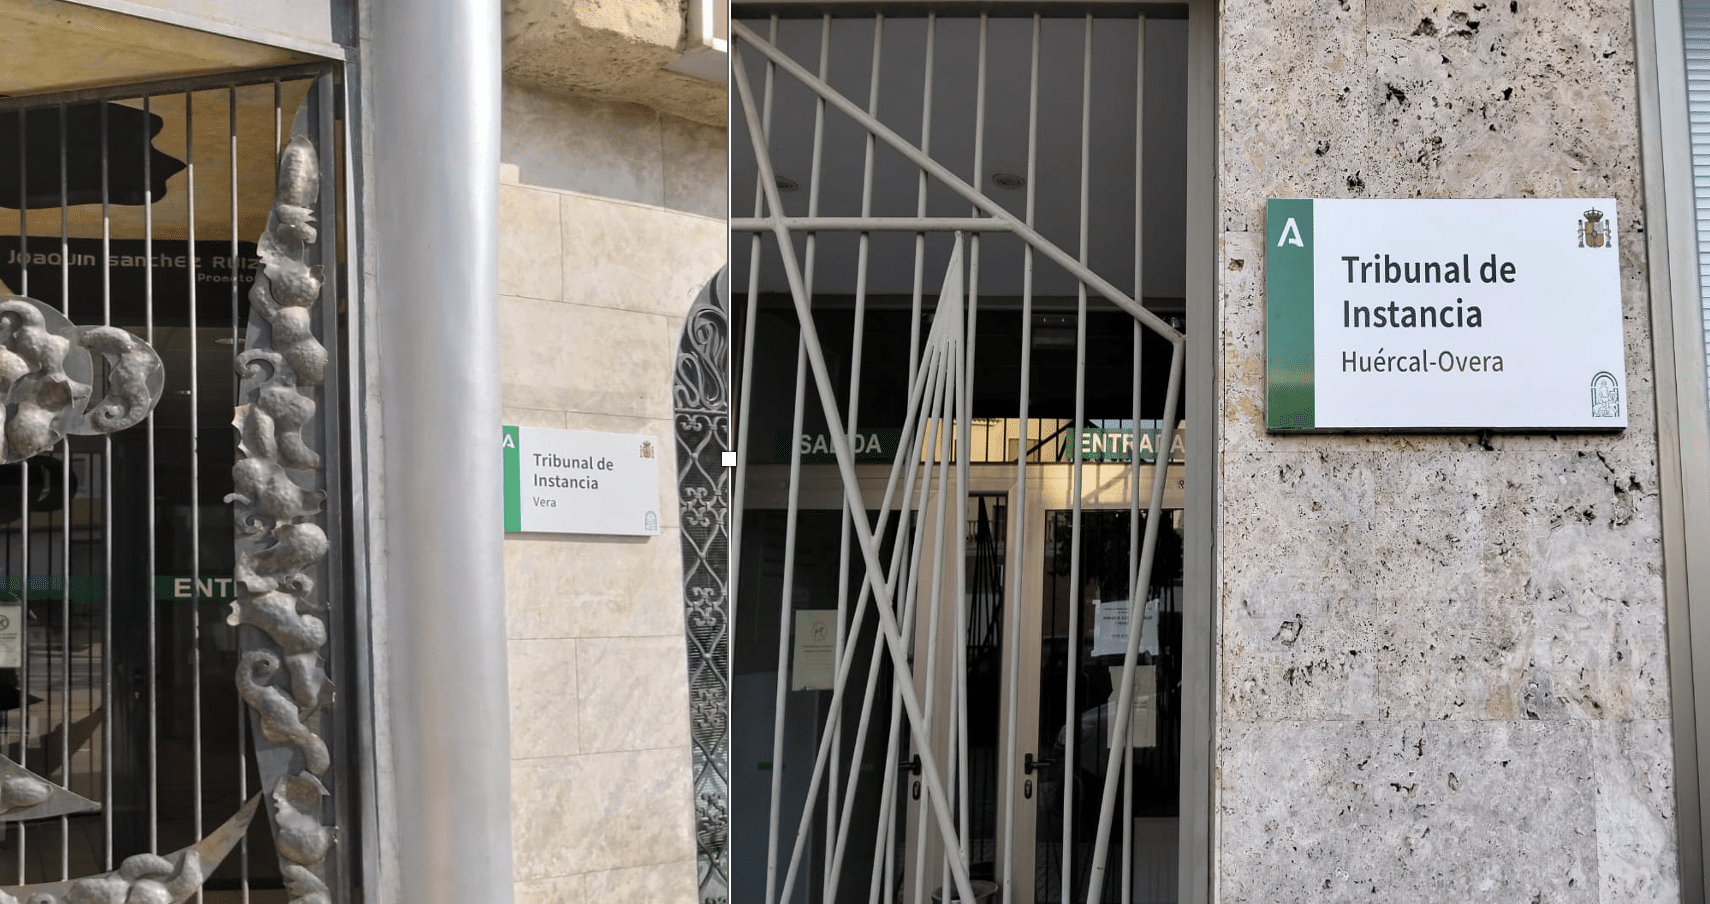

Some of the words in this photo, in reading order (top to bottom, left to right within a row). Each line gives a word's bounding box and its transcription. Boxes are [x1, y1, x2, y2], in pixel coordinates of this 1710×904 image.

[1341, 253, 1471, 284] Tribunal
[1479, 253, 1517, 284] de
[1343, 297, 1483, 328] Instancia
[1341, 347, 1505, 373] Huércal-Overa
[799, 433, 882, 455] SALDA
[533, 453, 594, 470] Tribunal
[597, 457, 614, 471] de
[534, 473, 599, 490] Instancia
[533, 497, 557, 508] Vera
[174, 578, 238, 598] ENT
